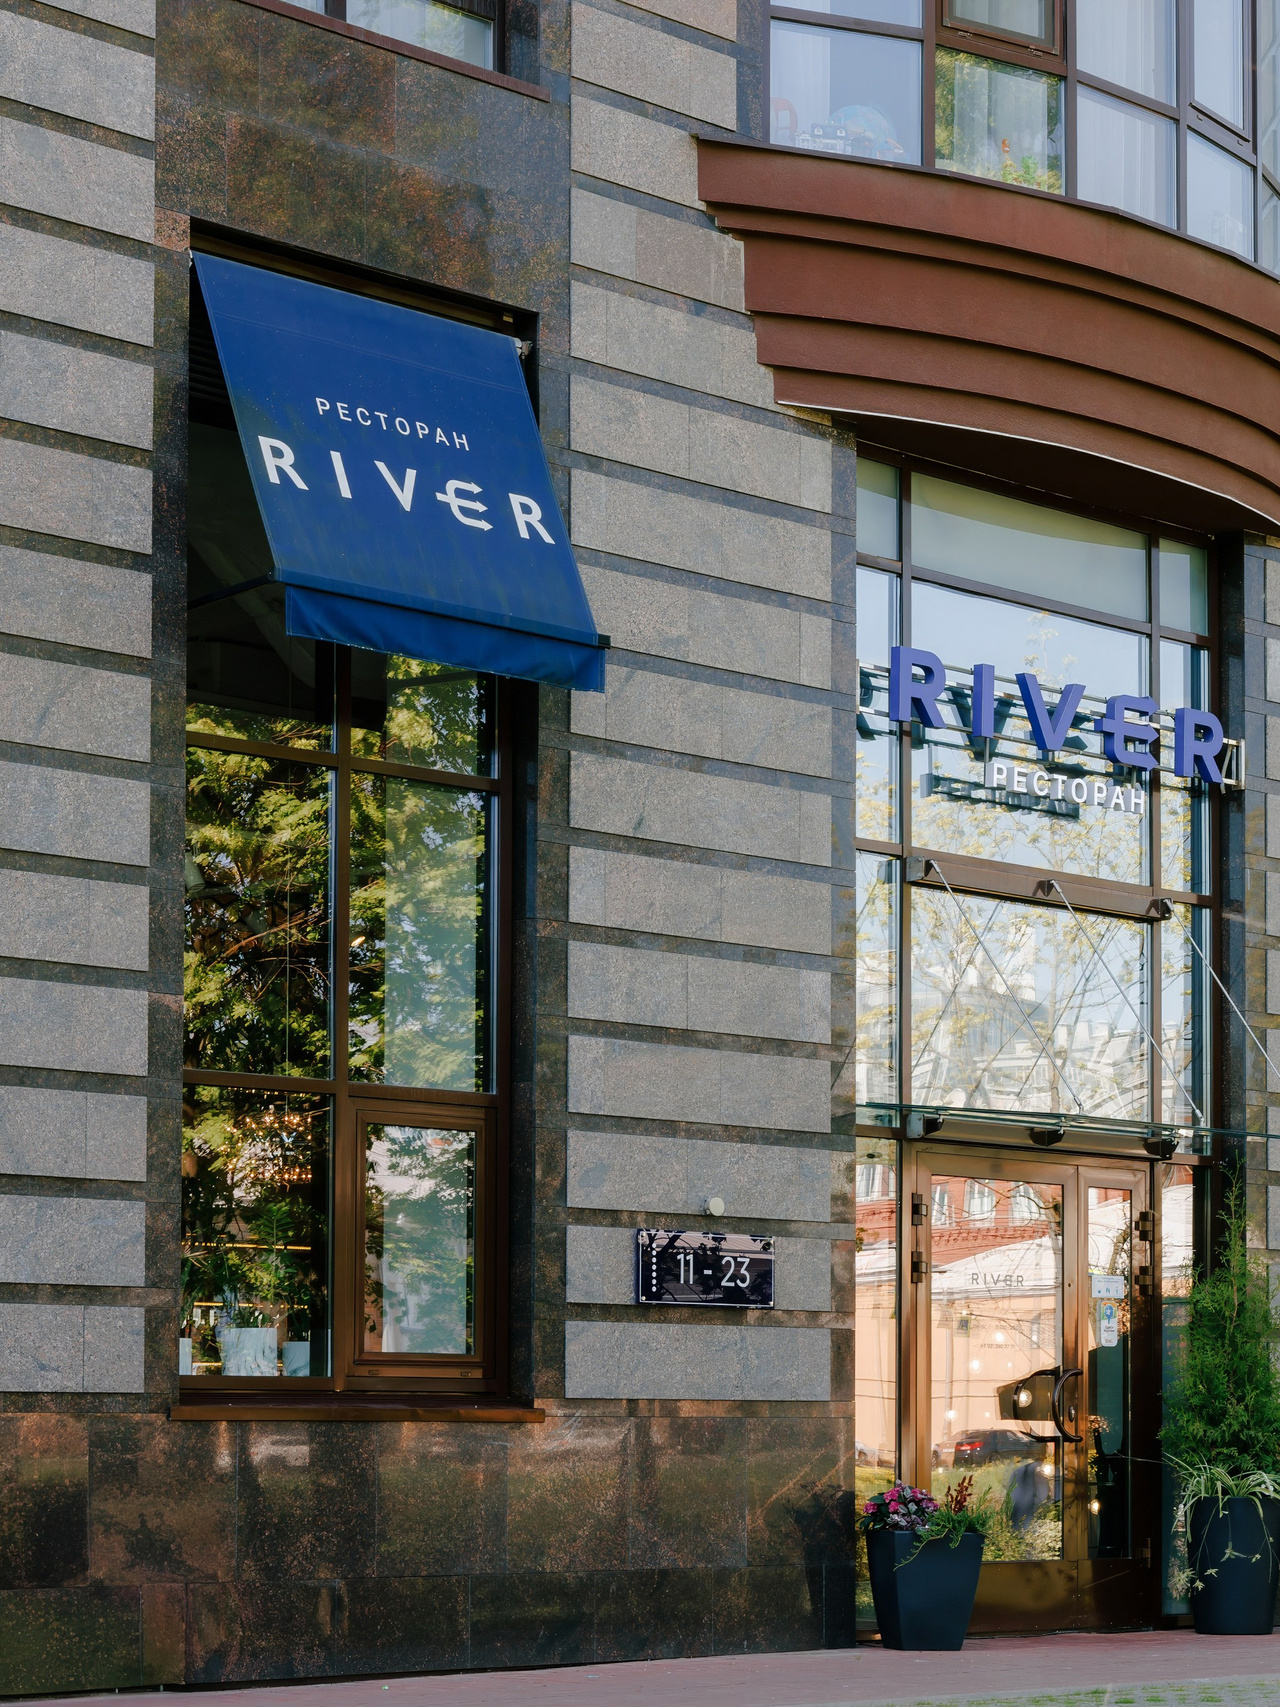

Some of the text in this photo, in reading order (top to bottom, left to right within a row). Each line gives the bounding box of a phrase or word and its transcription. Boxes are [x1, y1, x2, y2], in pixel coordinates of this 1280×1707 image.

[315, 397, 470, 452] РЕСТОРАН
[257, 435, 555, 545] RIVER
[888, 645, 1225, 784] RIVER
[985, 761, 1146, 814] РЕСТОРАН
[676, 1253, 694, 1285] 11
[720, 1256, 750, 1288] 23
[971, 1272, 1024, 1287] RIVER
